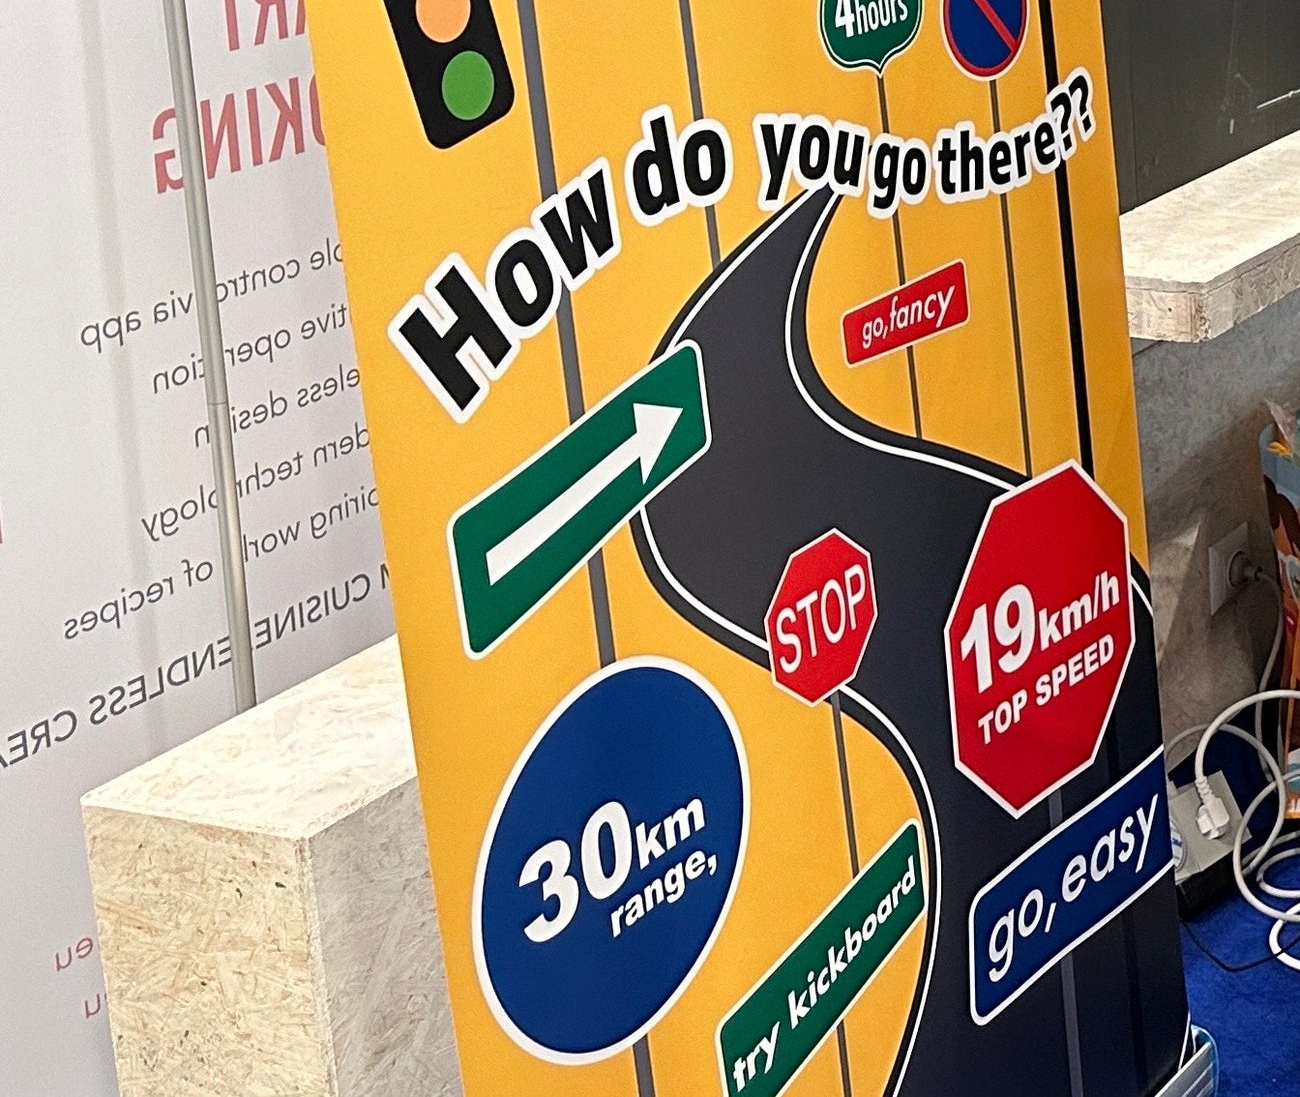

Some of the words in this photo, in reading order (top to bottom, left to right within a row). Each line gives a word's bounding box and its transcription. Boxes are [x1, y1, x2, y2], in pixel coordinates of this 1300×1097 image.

[397, 167, 617, 409] How
[631, 116, 727, 216] do
[758, 122, 860, 202] you
[873, 144, 927, 209] go
[775, 566, 867, 674] STOP
[977, 691, 1029, 746] TOP
[1034, 632, 1116, 707] SPEED
[609, 850, 718, 939] range,
[731, 1019, 782, 1094] try
[786, 855, 918, 1031] kickboard
